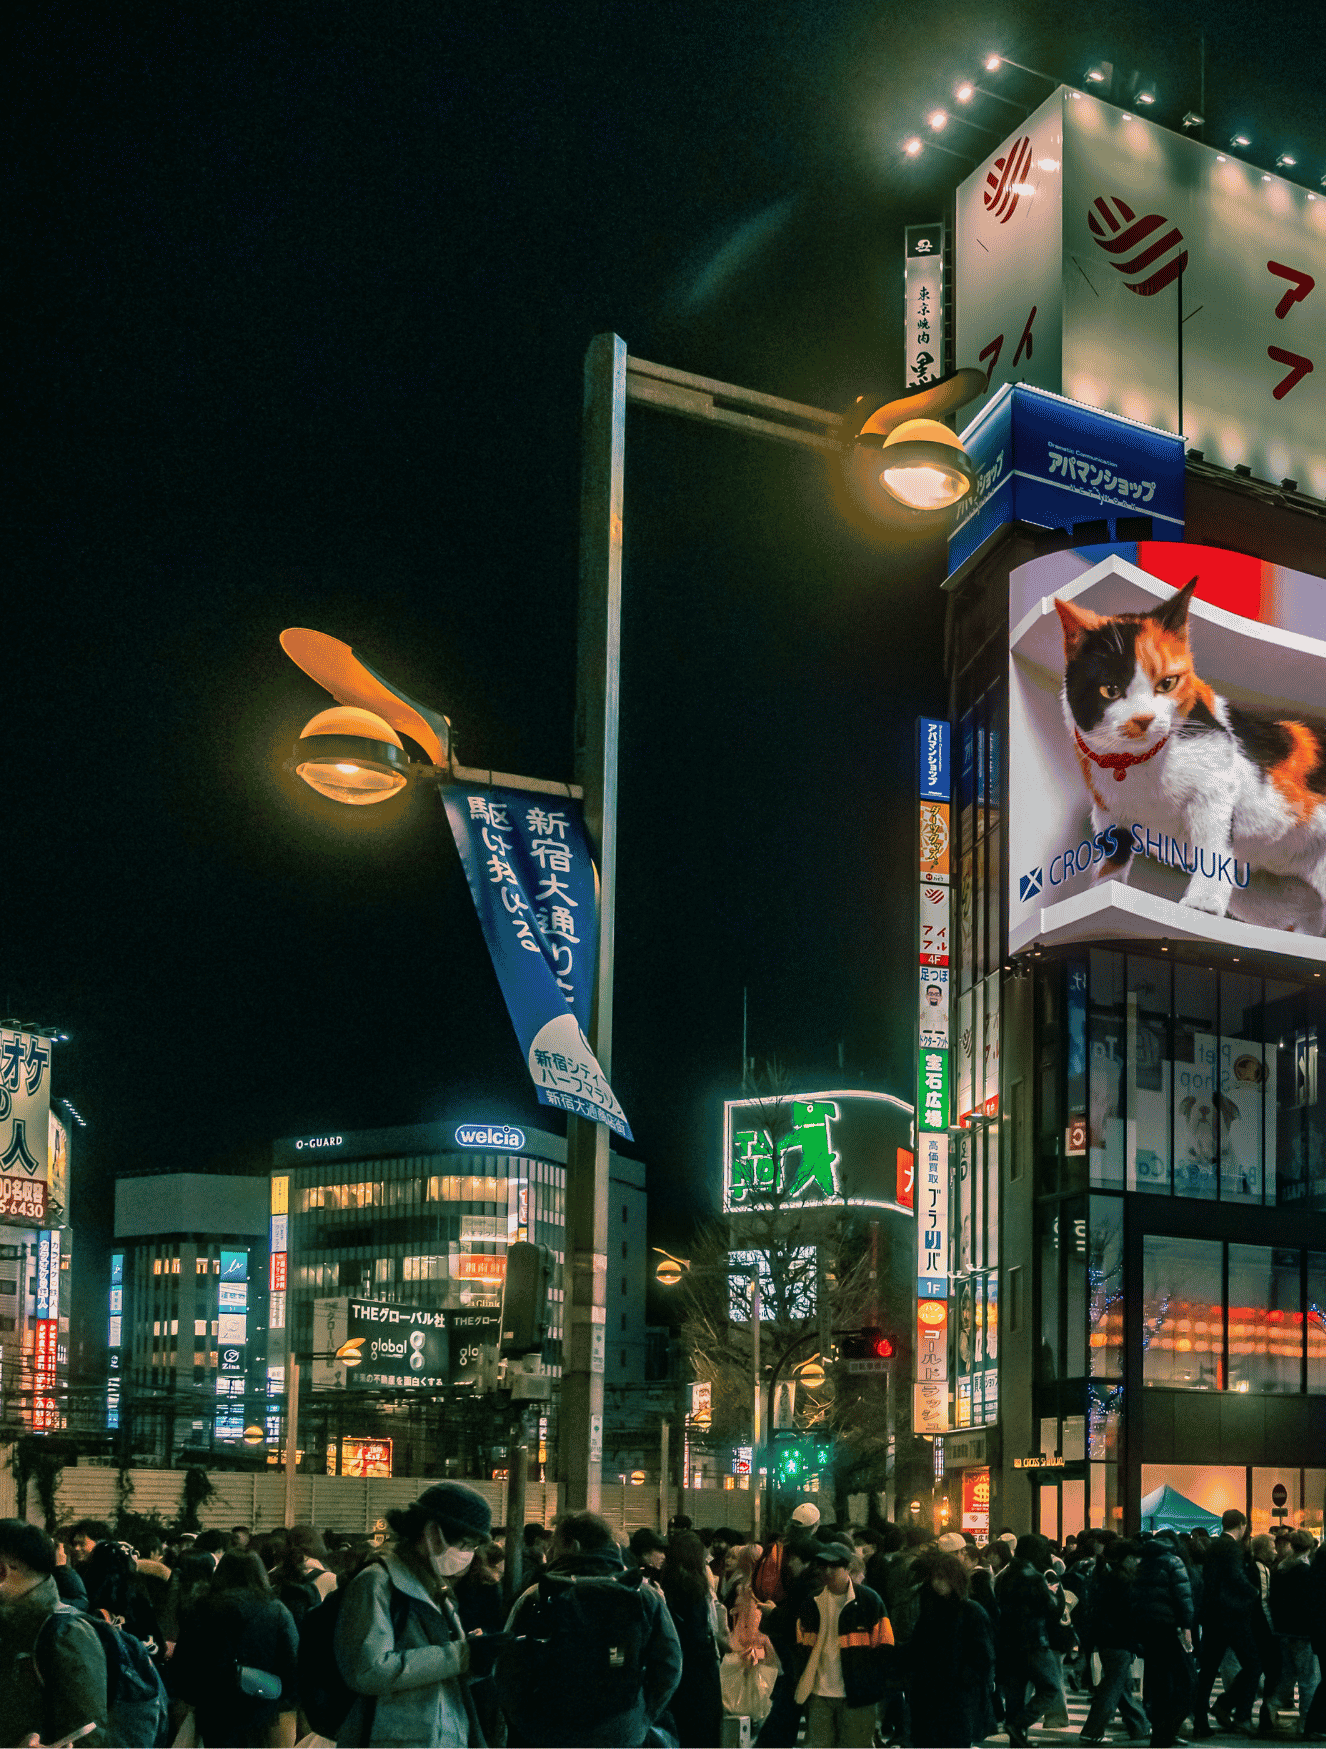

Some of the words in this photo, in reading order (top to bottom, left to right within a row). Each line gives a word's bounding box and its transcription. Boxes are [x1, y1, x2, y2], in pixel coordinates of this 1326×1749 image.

[1048, 451, 1157, 502] アパマンショップ
[928, 723, 938, 786] アパマンショップ
[1049, 824, 1119, 886] CROSS
[1130, 823, 1251, 889] SHINJUKU
[928, 954, 941, 965] 4F
[542, 1068, 622, 1115] ハーフマラソ
[924, 1053, 943, 1128] 宝石広場
[460, 1125, 520, 1147] welcia
[928, 1140, 939, 1184] 高価買取
[925, 1188, 942, 1271] ブラリバ
[926, 1281, 941, 1295] 1F
[351, 1304, 446, 1328] THEグローバル社
[454, 1316, 502, 1326] THEグロー
[370, 1338, 408, 1361] global
